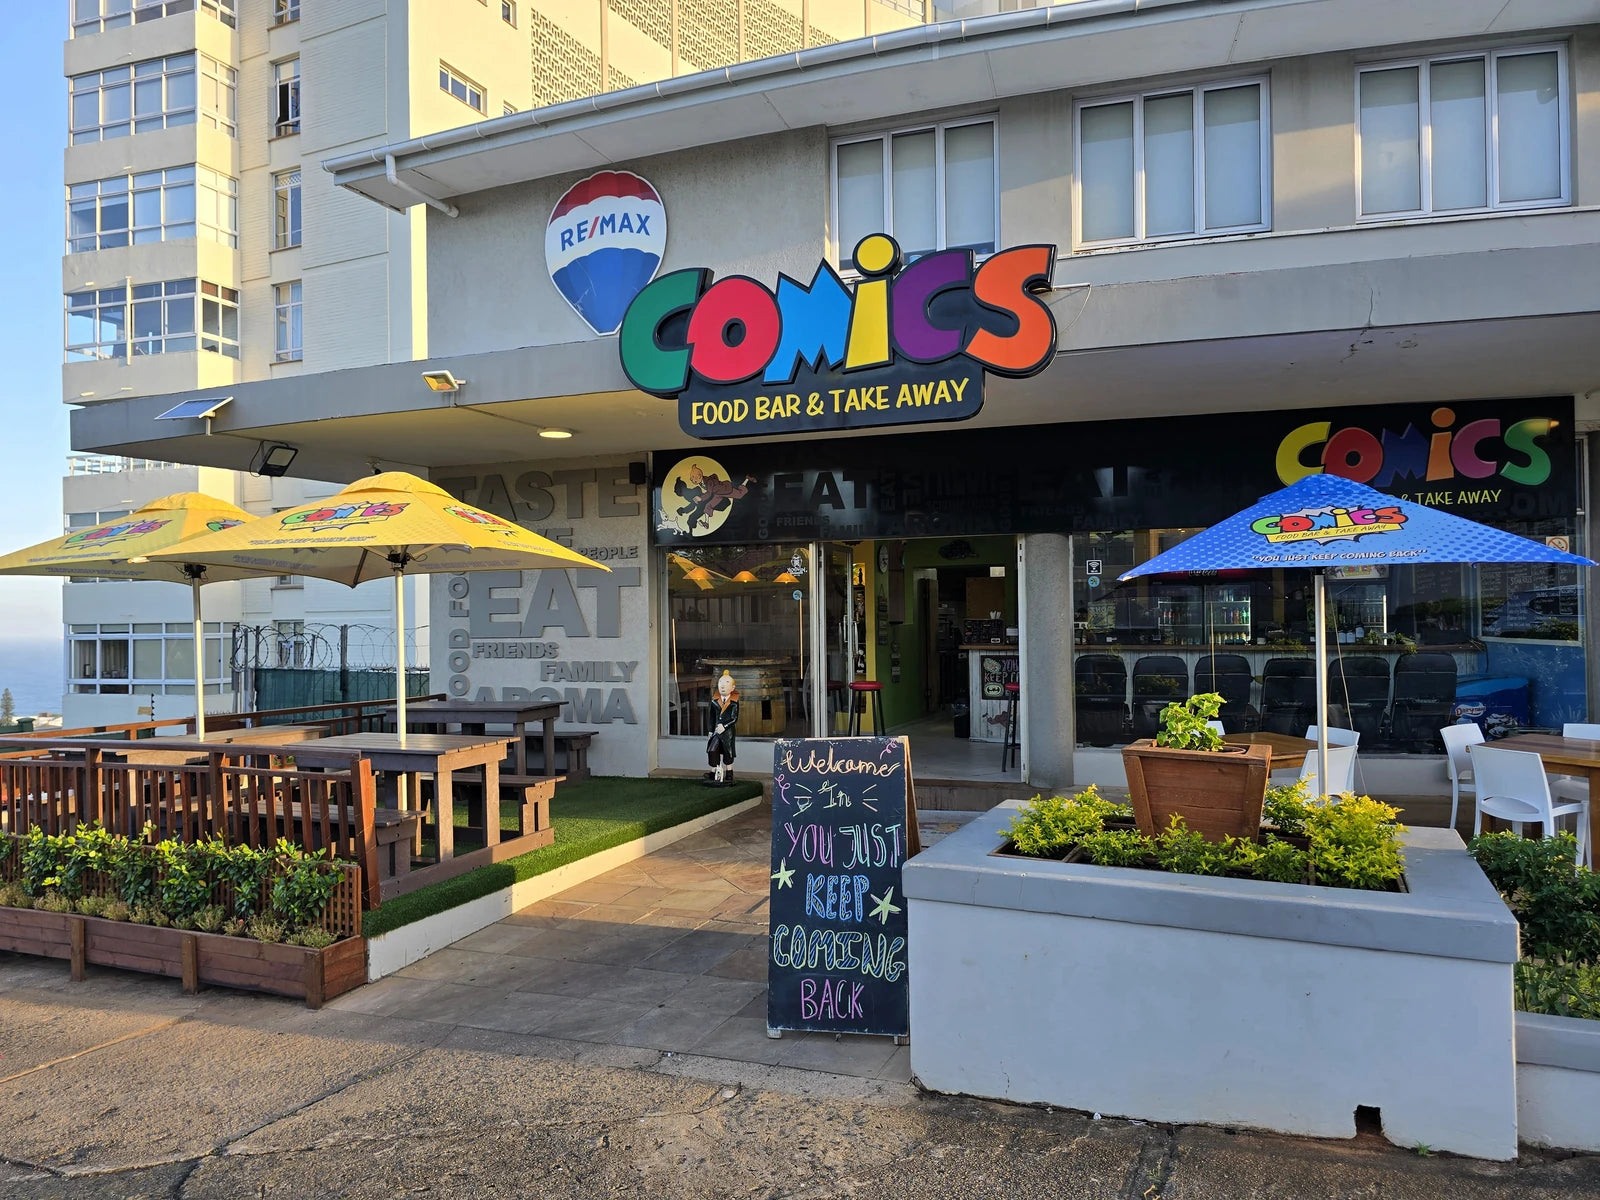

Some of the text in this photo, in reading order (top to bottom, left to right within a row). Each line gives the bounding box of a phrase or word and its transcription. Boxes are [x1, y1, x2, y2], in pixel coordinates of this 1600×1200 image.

[561, 213, 650, 252] RE/MAX
[691, 377, 970, 425] FOOD BAR & TAKE AWAY
[438, 466, 640, 521] TASTE
[1415, 491, 1454, 505] TAKE
[1457, 489, 1501, 504] AWAY
[1360, 524, 1387, 532] AWAY
[580, 546, 639, 559] PEOPLE
[1282, 554, 1309, 562] JUST
[1311, 553, 1337, 561] KEEP
[1340, 551, 1386, 560] COMING
[469, 567, 641, 638] EAT
[449, 571, 470, 704] OOD FO
[472, 642, 560, 659] FRIENDS
[540, 661, 639, 682] FAMILY
[984, 671, 1008, 685] KEEP
[781, 748, 900, 777] Welcome
[784, 822, 901, 870] YOU JUST
[805, 873, 870, 922] KEEP
[773, 924, 905, 982] COMING
[801, 978, 864, 1021] BACK
